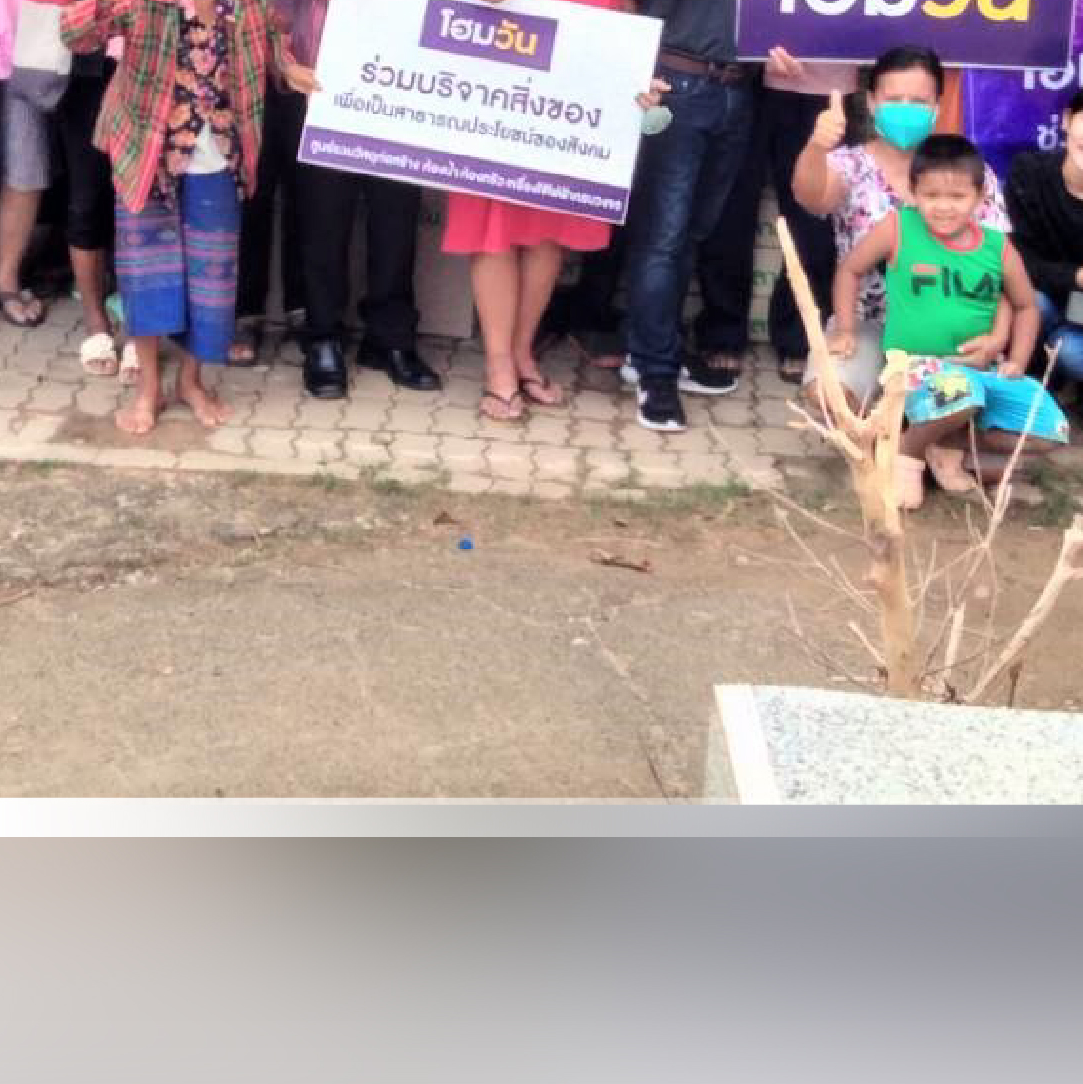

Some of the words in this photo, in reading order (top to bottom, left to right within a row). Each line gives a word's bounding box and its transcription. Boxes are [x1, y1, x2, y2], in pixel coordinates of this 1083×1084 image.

[440, 9, 538, 56] โฮมวัน
[360, 54, 602, 128] ร่วมบริจาคสิ่งของ
[910, 264, 1004, 302] FILA
